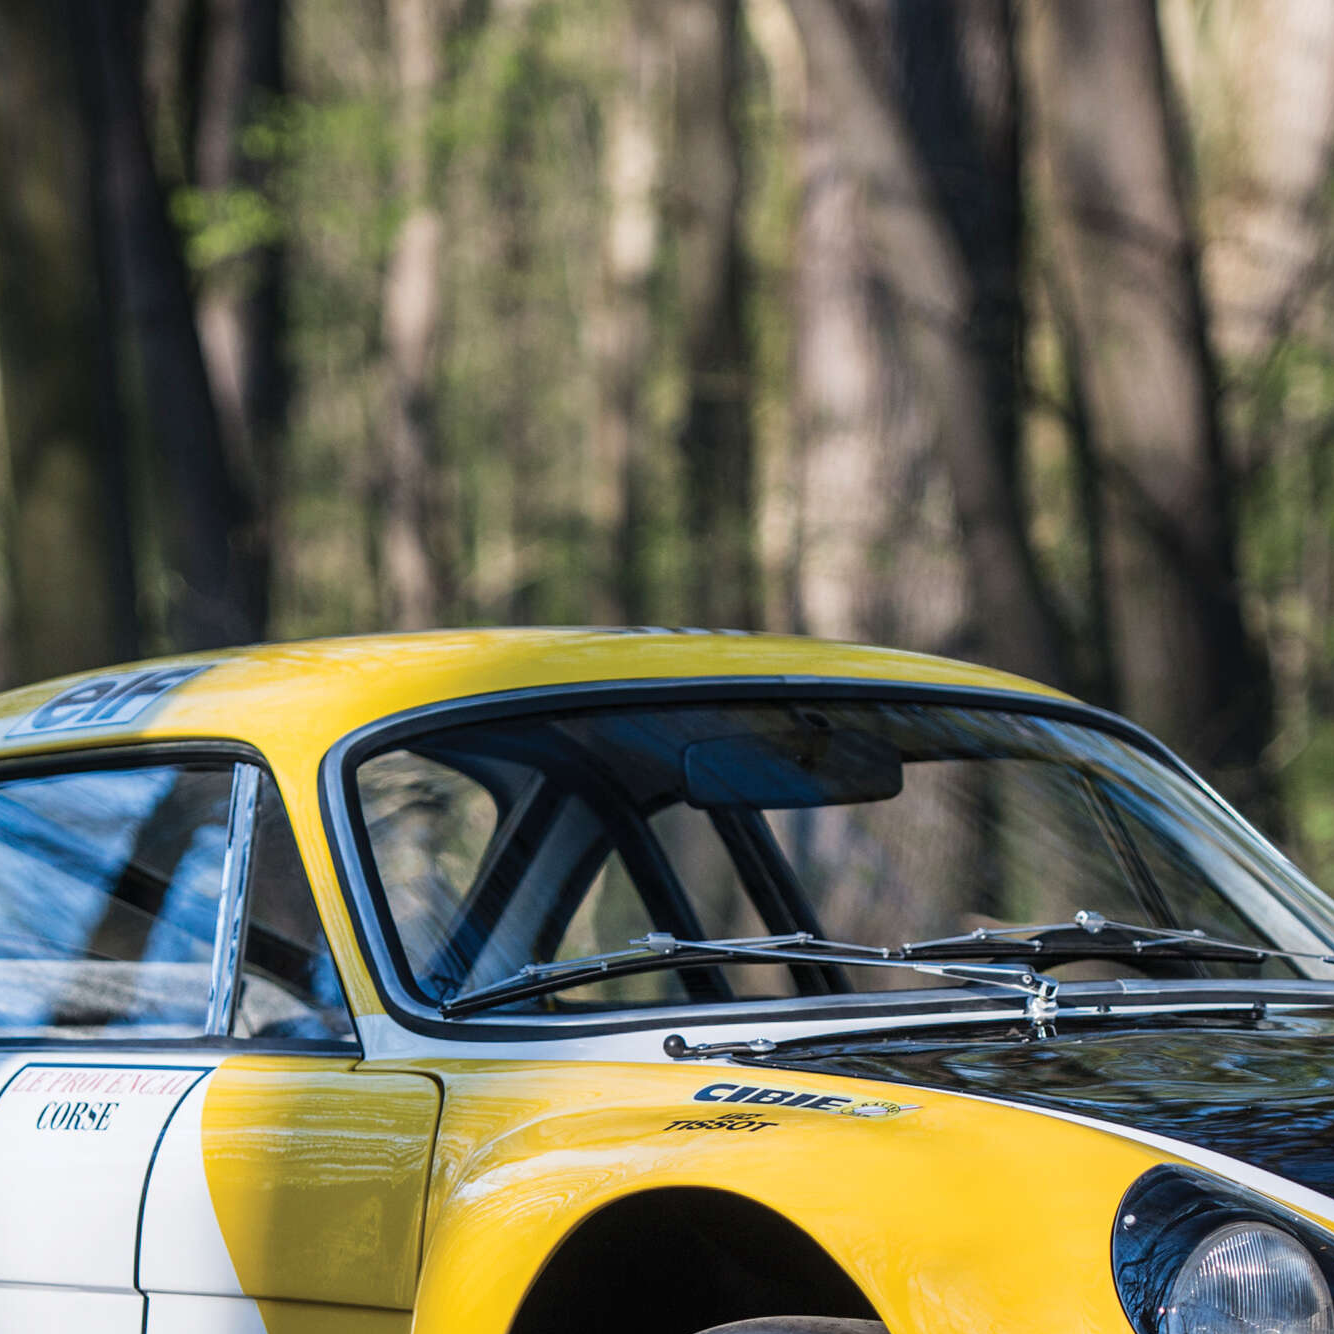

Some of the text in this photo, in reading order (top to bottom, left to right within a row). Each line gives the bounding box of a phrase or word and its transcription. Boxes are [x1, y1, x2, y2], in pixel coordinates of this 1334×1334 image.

[32, 664, 216, 729] elf
[36, 1101, 119, 1131] CORSE
[663, 1120, 779, 1132] TISSOT
